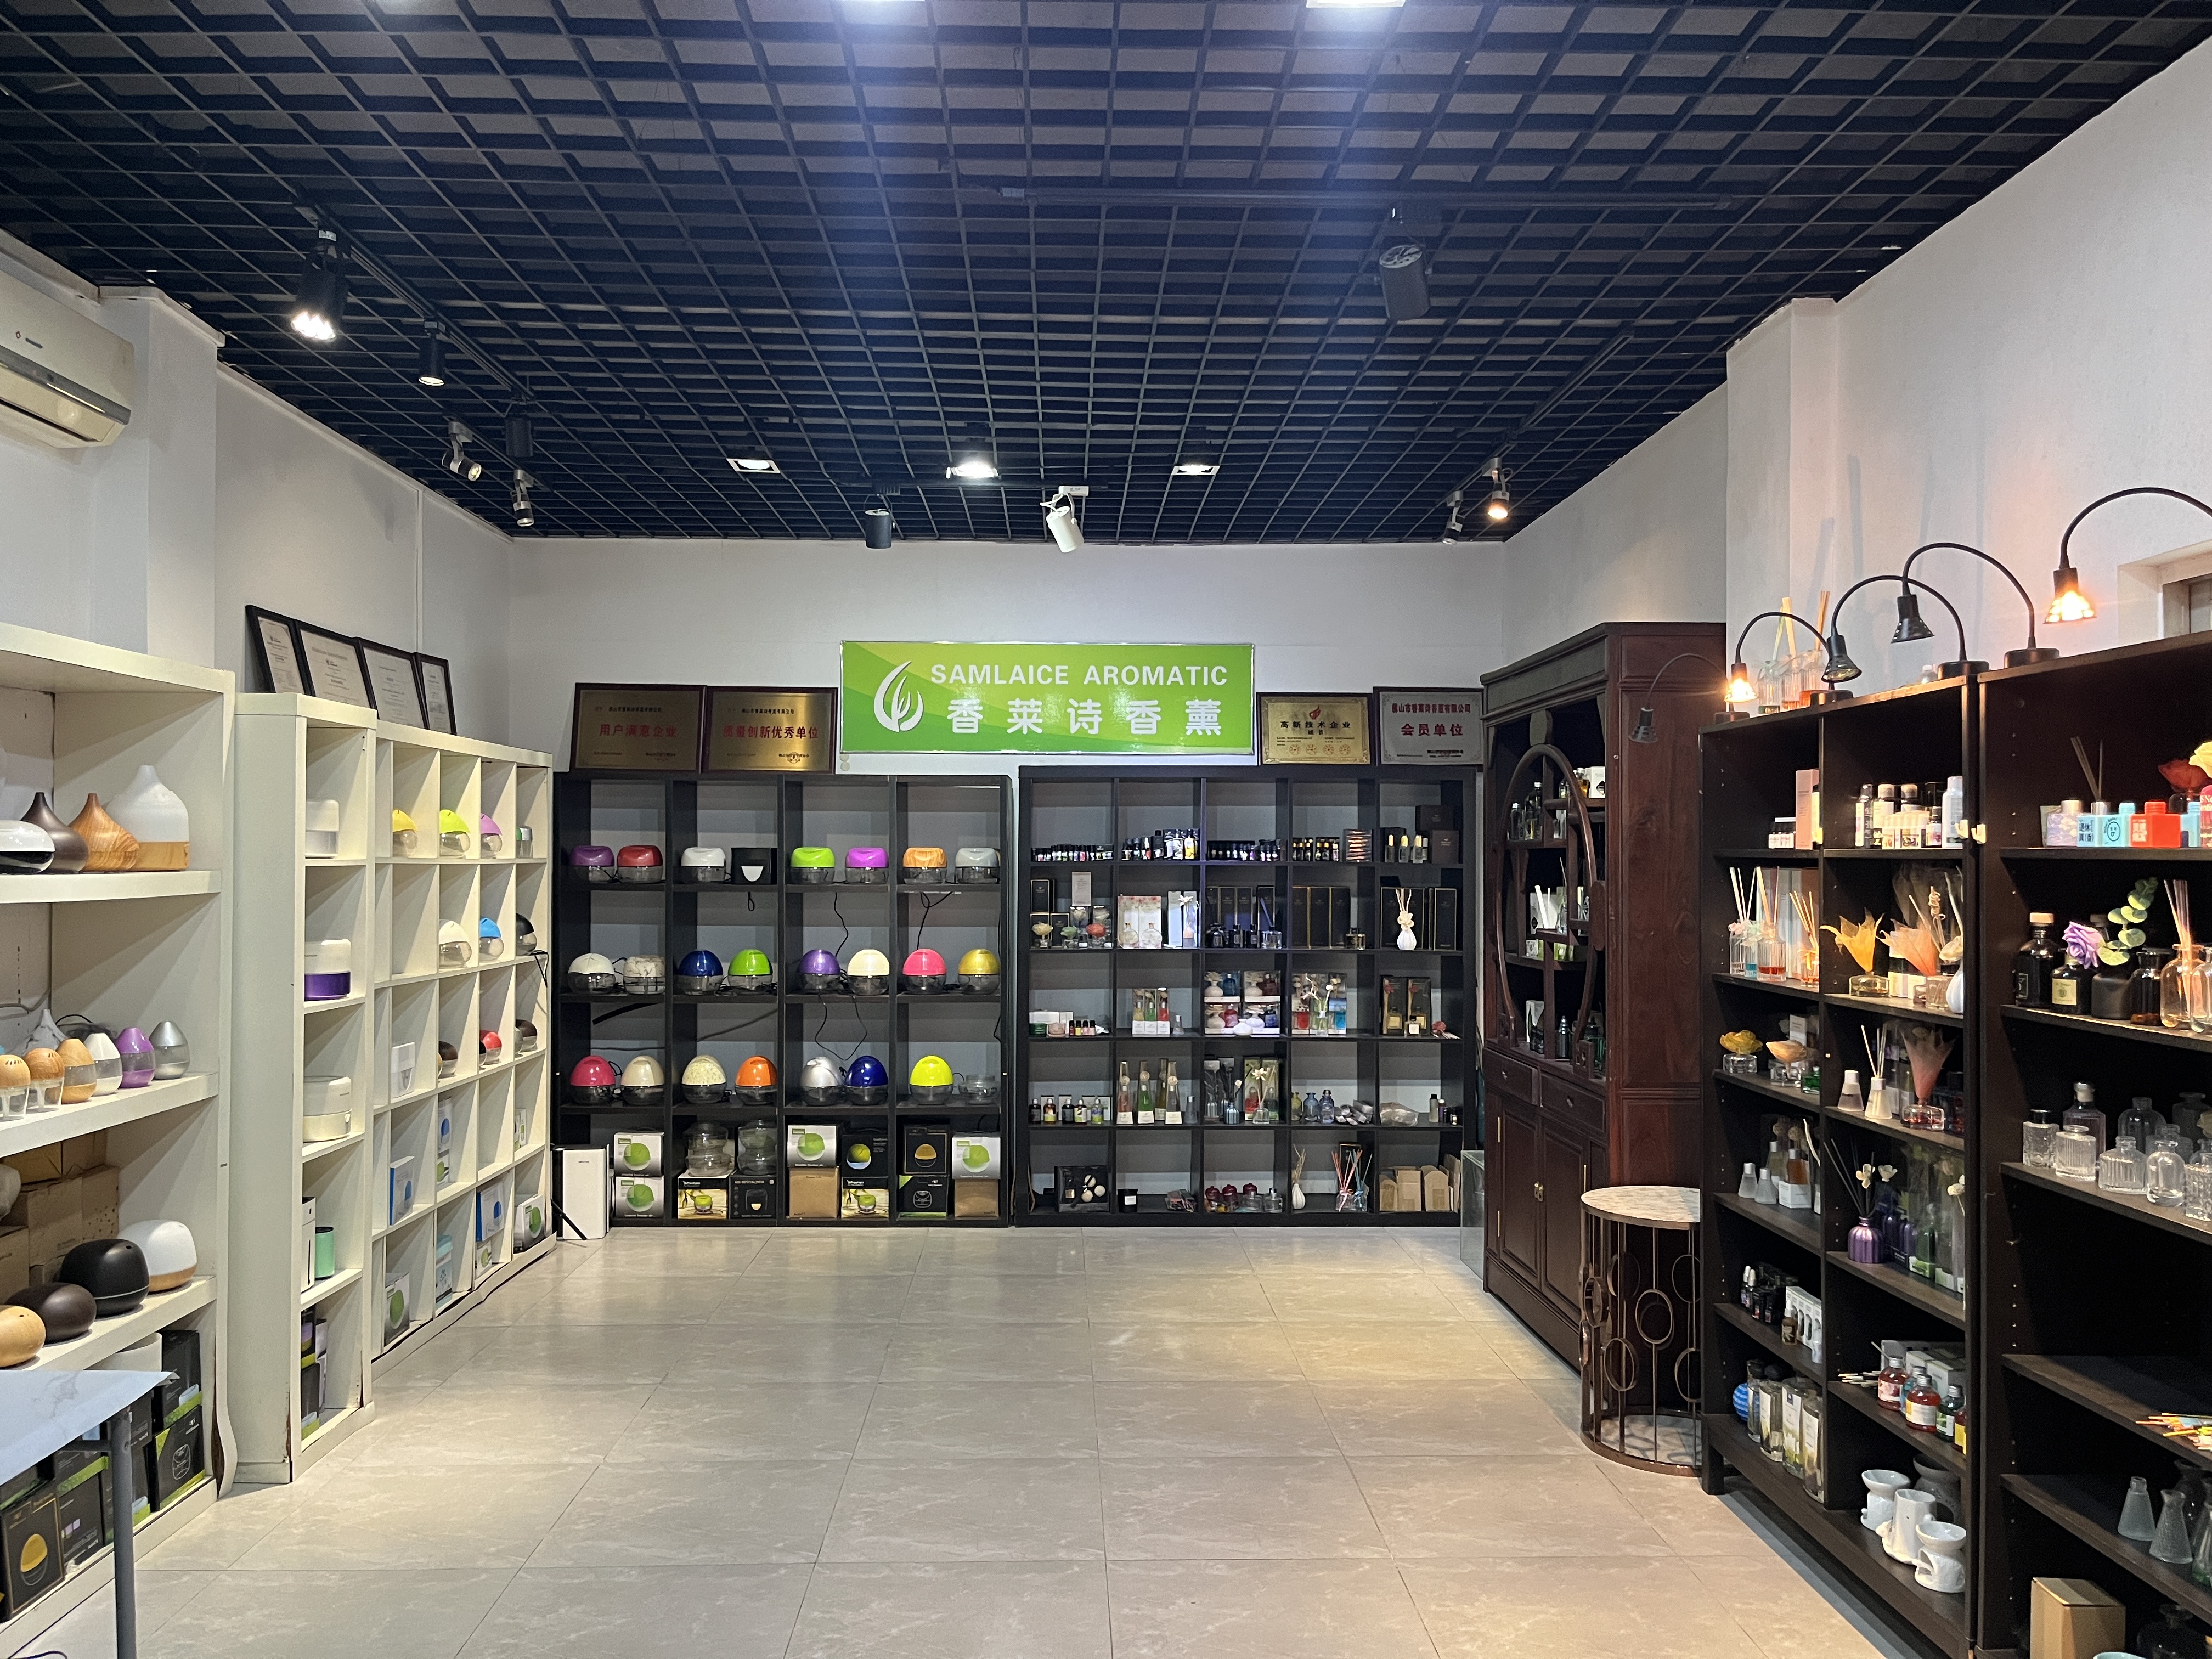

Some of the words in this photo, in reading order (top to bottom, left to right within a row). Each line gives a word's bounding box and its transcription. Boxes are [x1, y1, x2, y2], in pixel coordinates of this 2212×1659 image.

[931, 663, 1069, 685] SAMLAICE
[1084, 664, 1228, 686] AROMATIC
[947, 698, 1222, 736] 香莱诗香薰
[599, 723, 678, 738] 用户满意企业
[723, 725, 819, 739] 质量创新优秀单位
[1401, 723, 1464, 737] 会员单位
